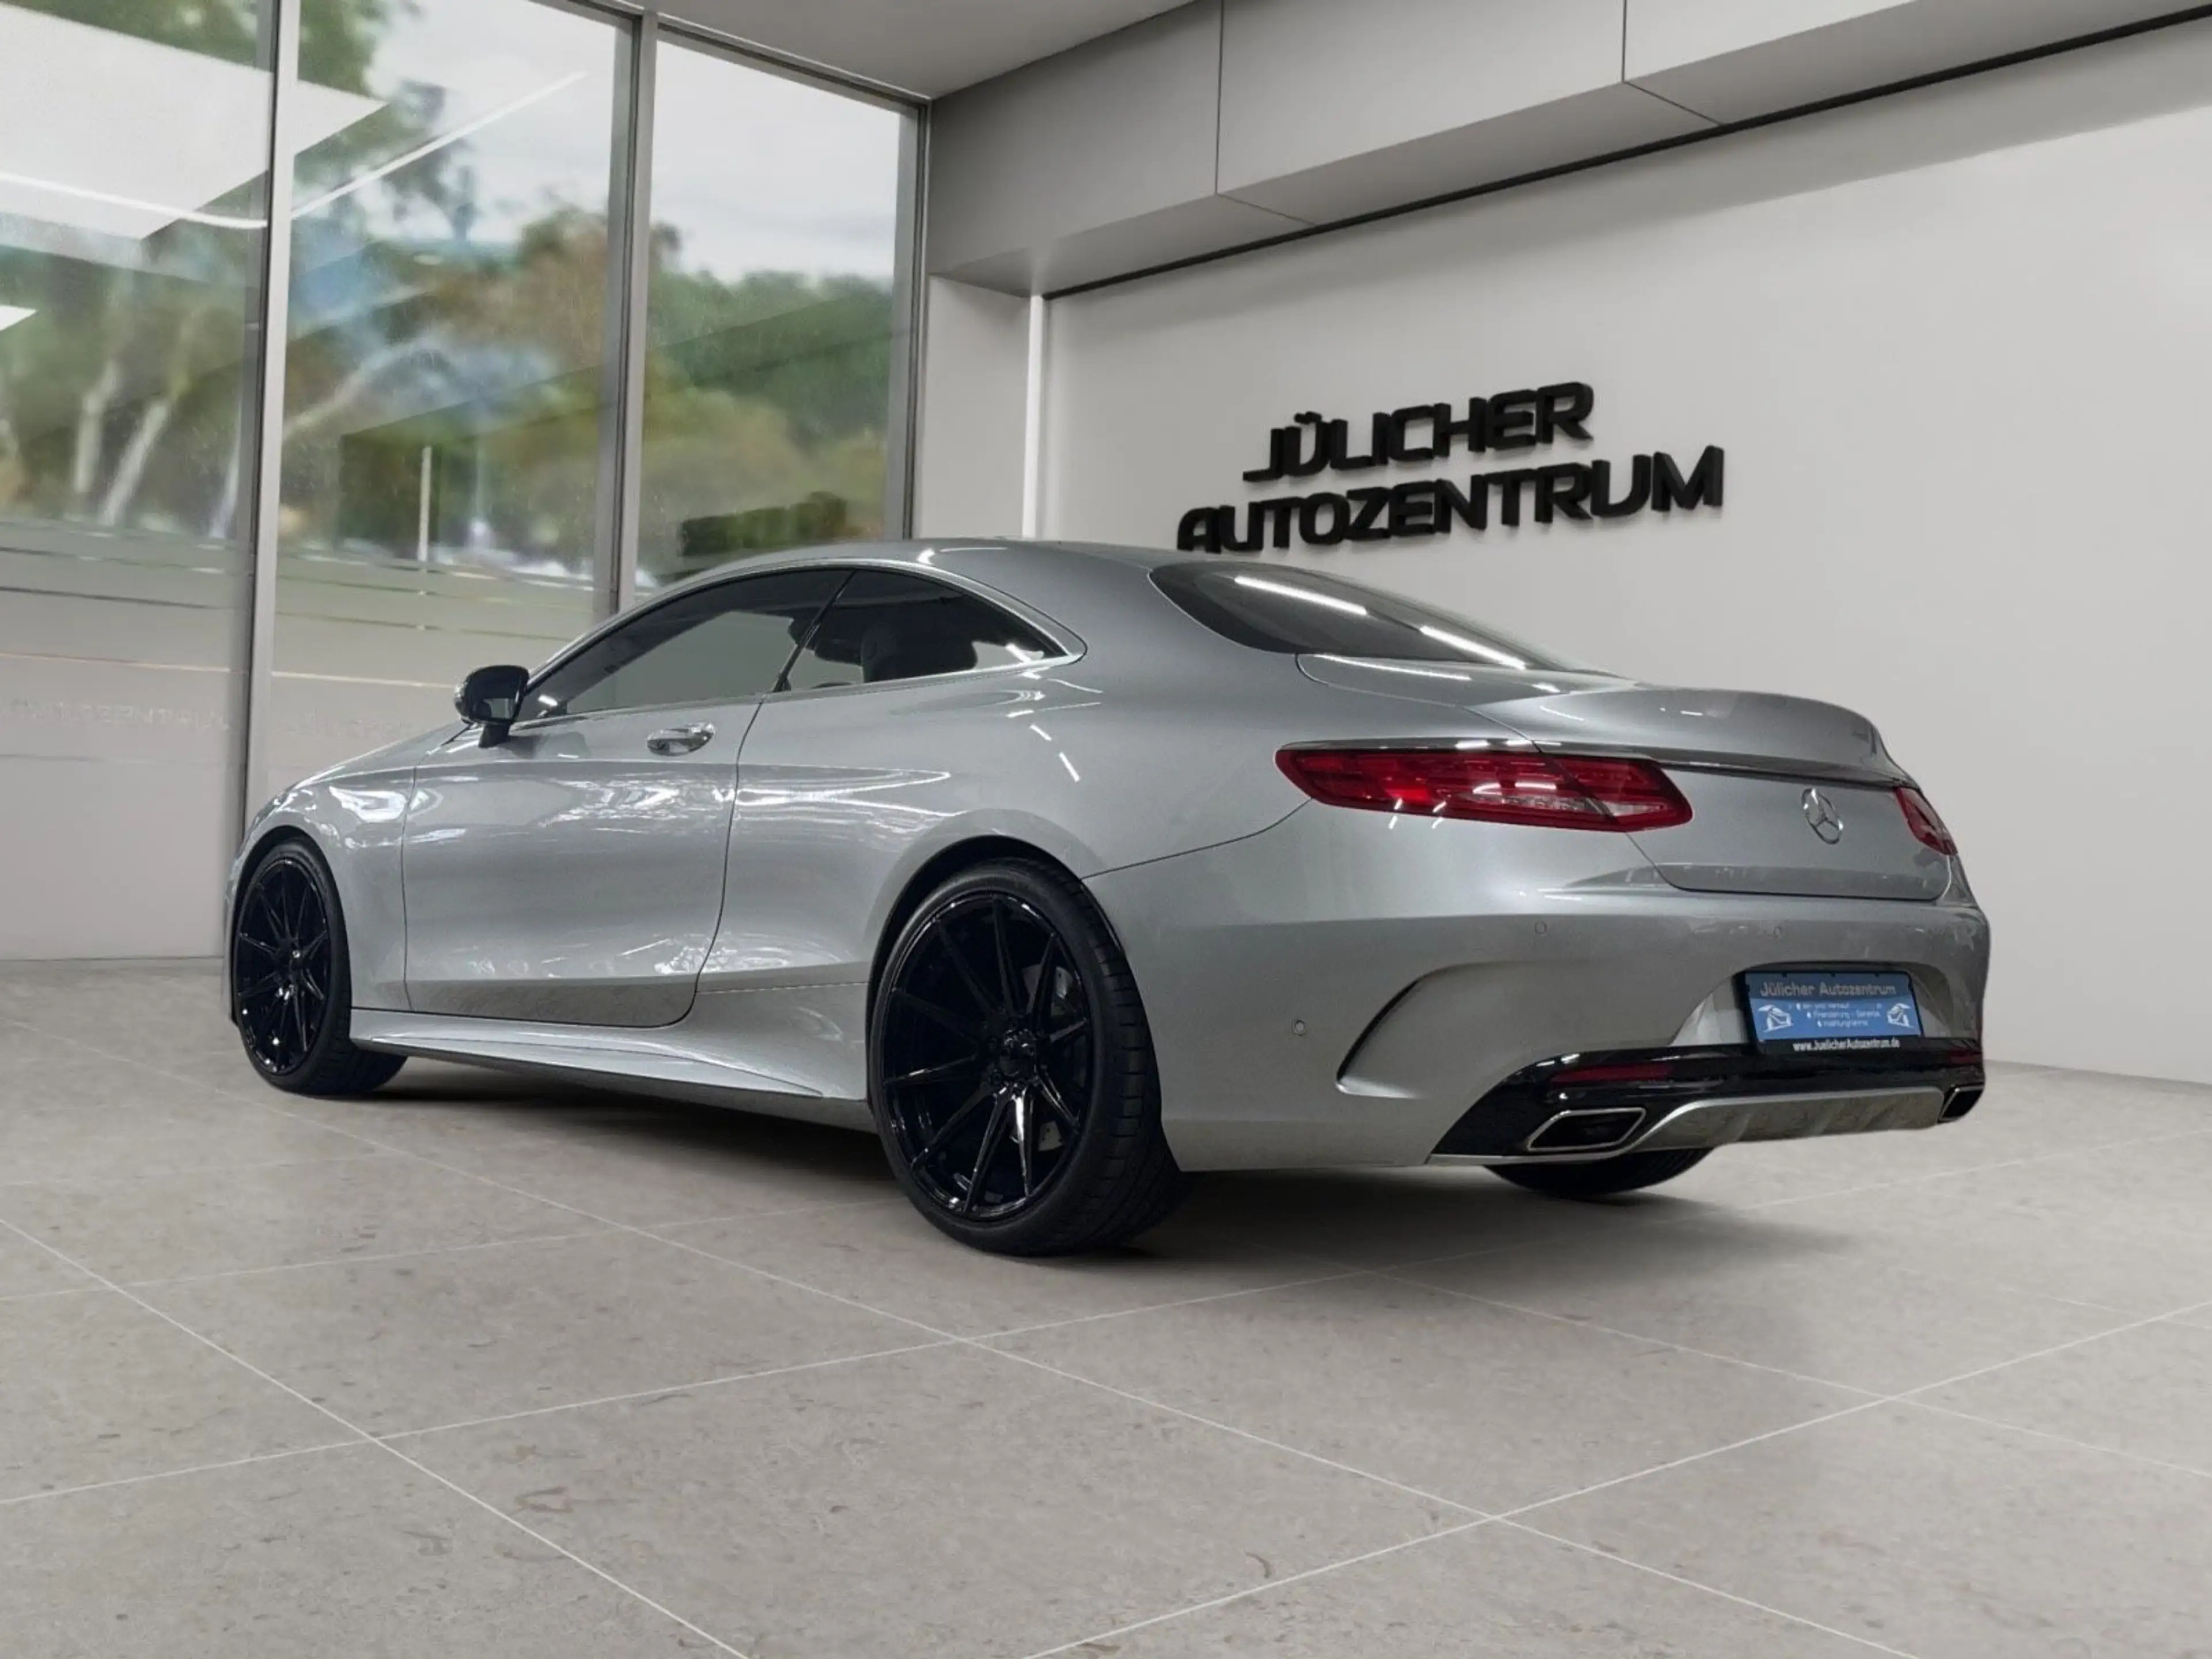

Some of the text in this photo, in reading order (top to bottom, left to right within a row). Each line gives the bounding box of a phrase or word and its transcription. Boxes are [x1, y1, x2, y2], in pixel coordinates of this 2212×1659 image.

[1243, 381, 1593, 482] JÜLICHER
[1177, 445, 1724, 553] AUTOZENTRUM
[1760, 981, 1896, 997] Jülicher Autozentrum
